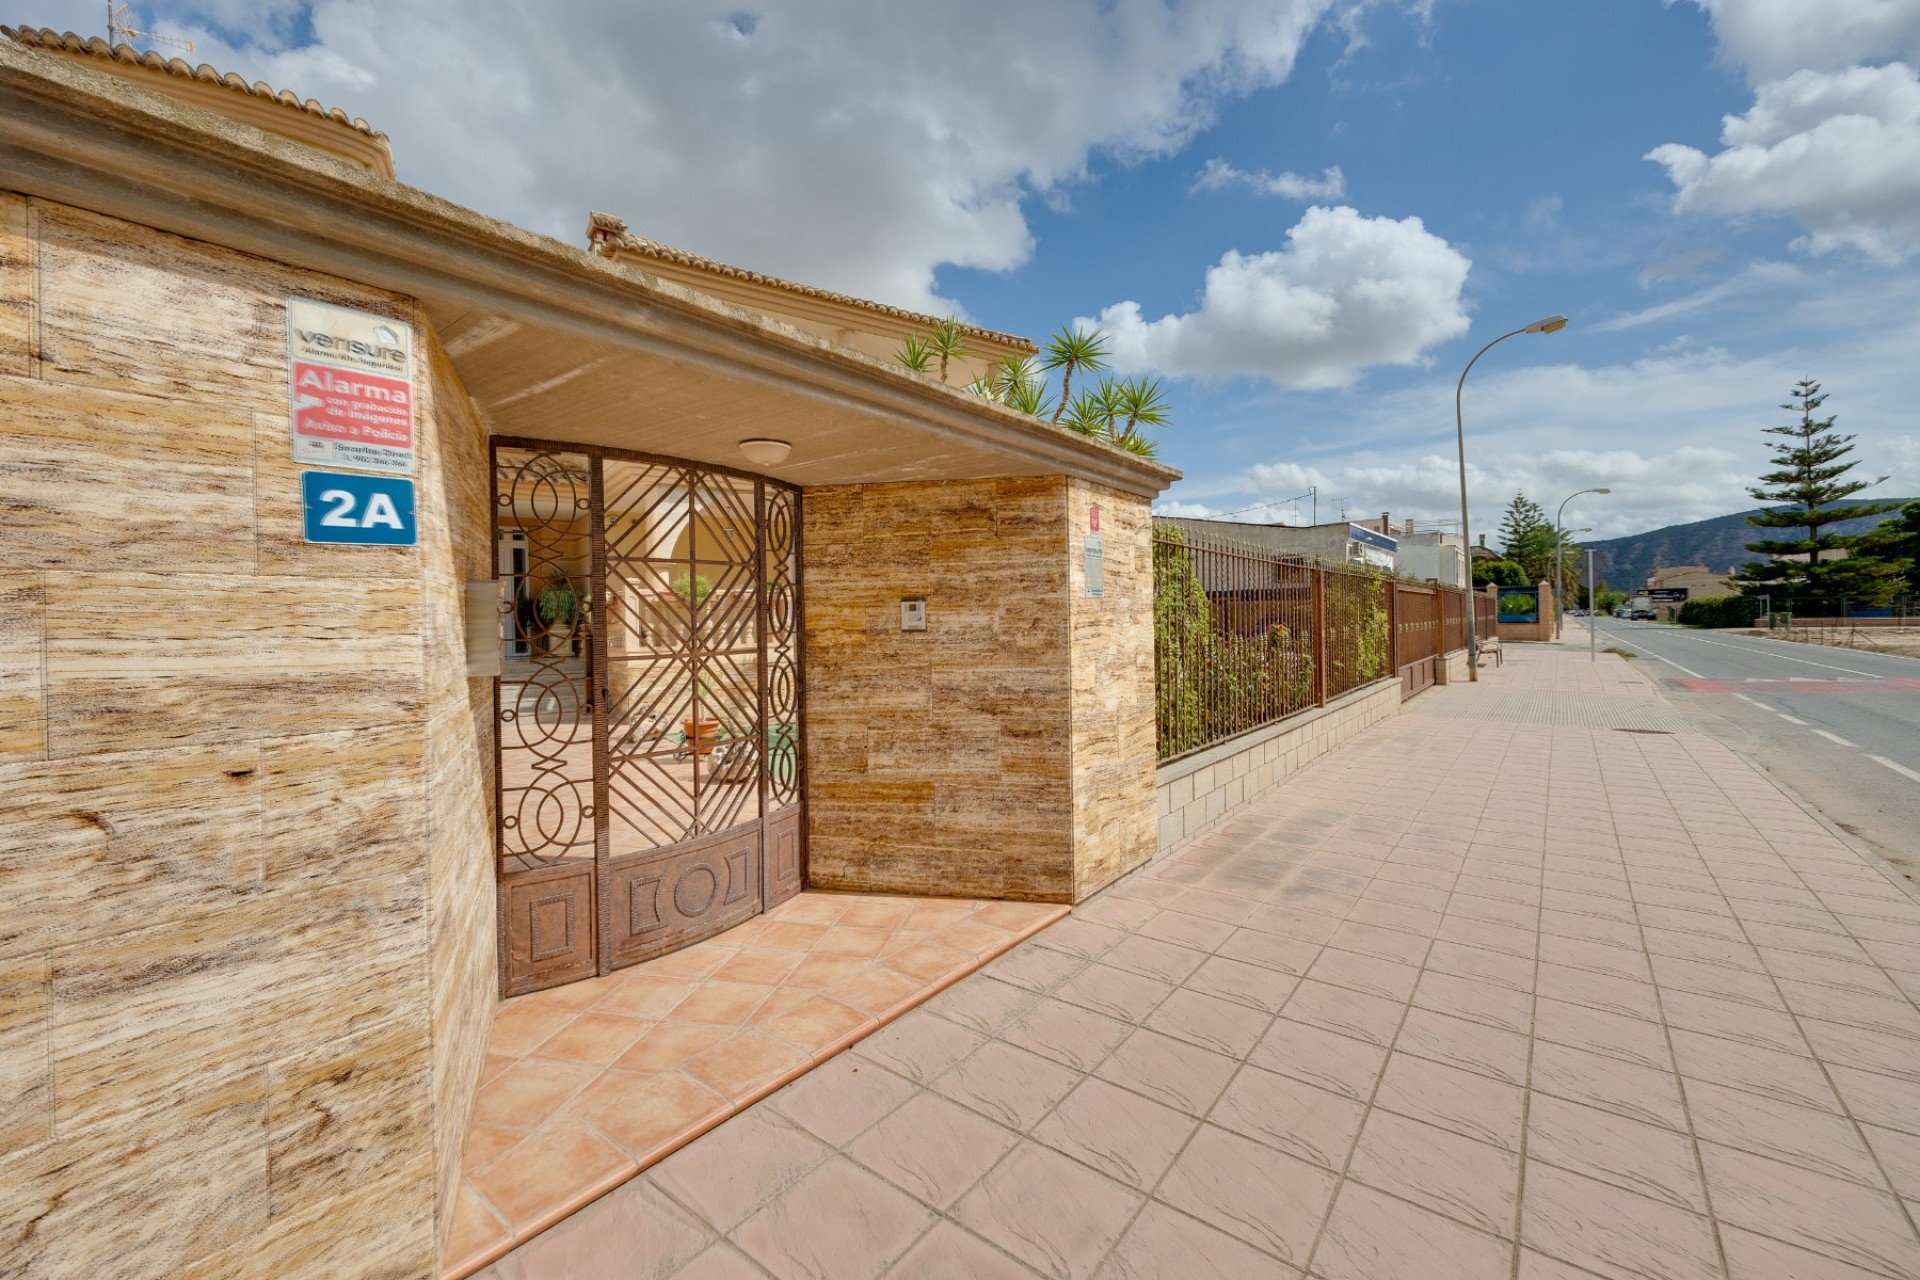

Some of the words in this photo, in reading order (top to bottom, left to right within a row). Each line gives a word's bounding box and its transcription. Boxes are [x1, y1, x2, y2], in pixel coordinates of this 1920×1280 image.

[294, 328, 406, 363] verisure
[300, 369, 407, 404] Alarma
[325, 396, 349, 407] con
[326, 406, 344, 417] de
[304, 419, 347, 433] Aviso
[349, 426, 359, 436] a
[320, 489, 404, 529] 2A
